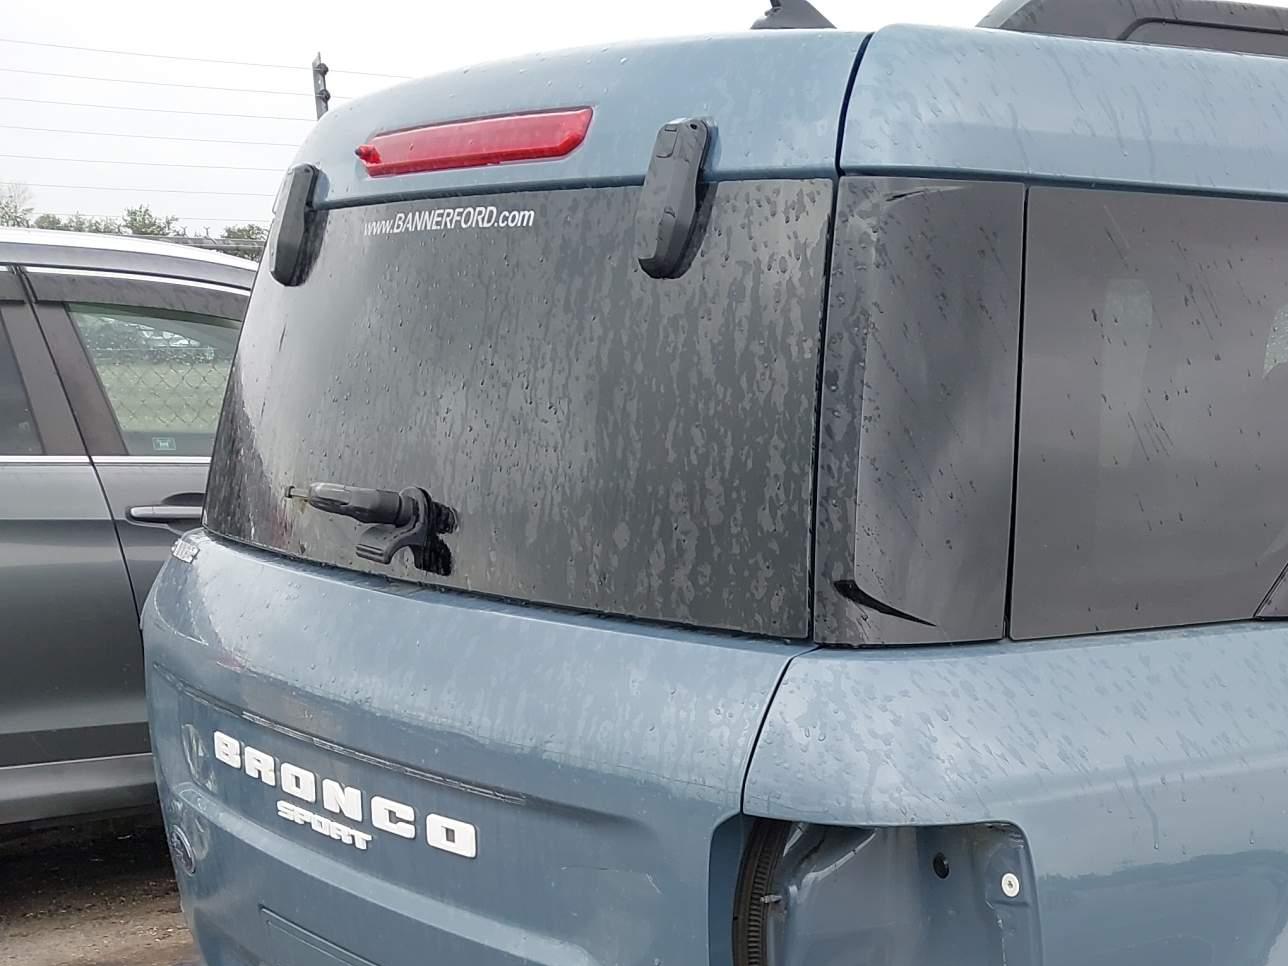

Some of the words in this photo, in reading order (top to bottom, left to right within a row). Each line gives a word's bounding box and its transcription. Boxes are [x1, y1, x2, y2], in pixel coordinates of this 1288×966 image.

[363, 205, 535, 237] www.BANNERFORD.com
[213, 730, 477, 859] BRONCO
[276, 800, 373, 851] SPORT
